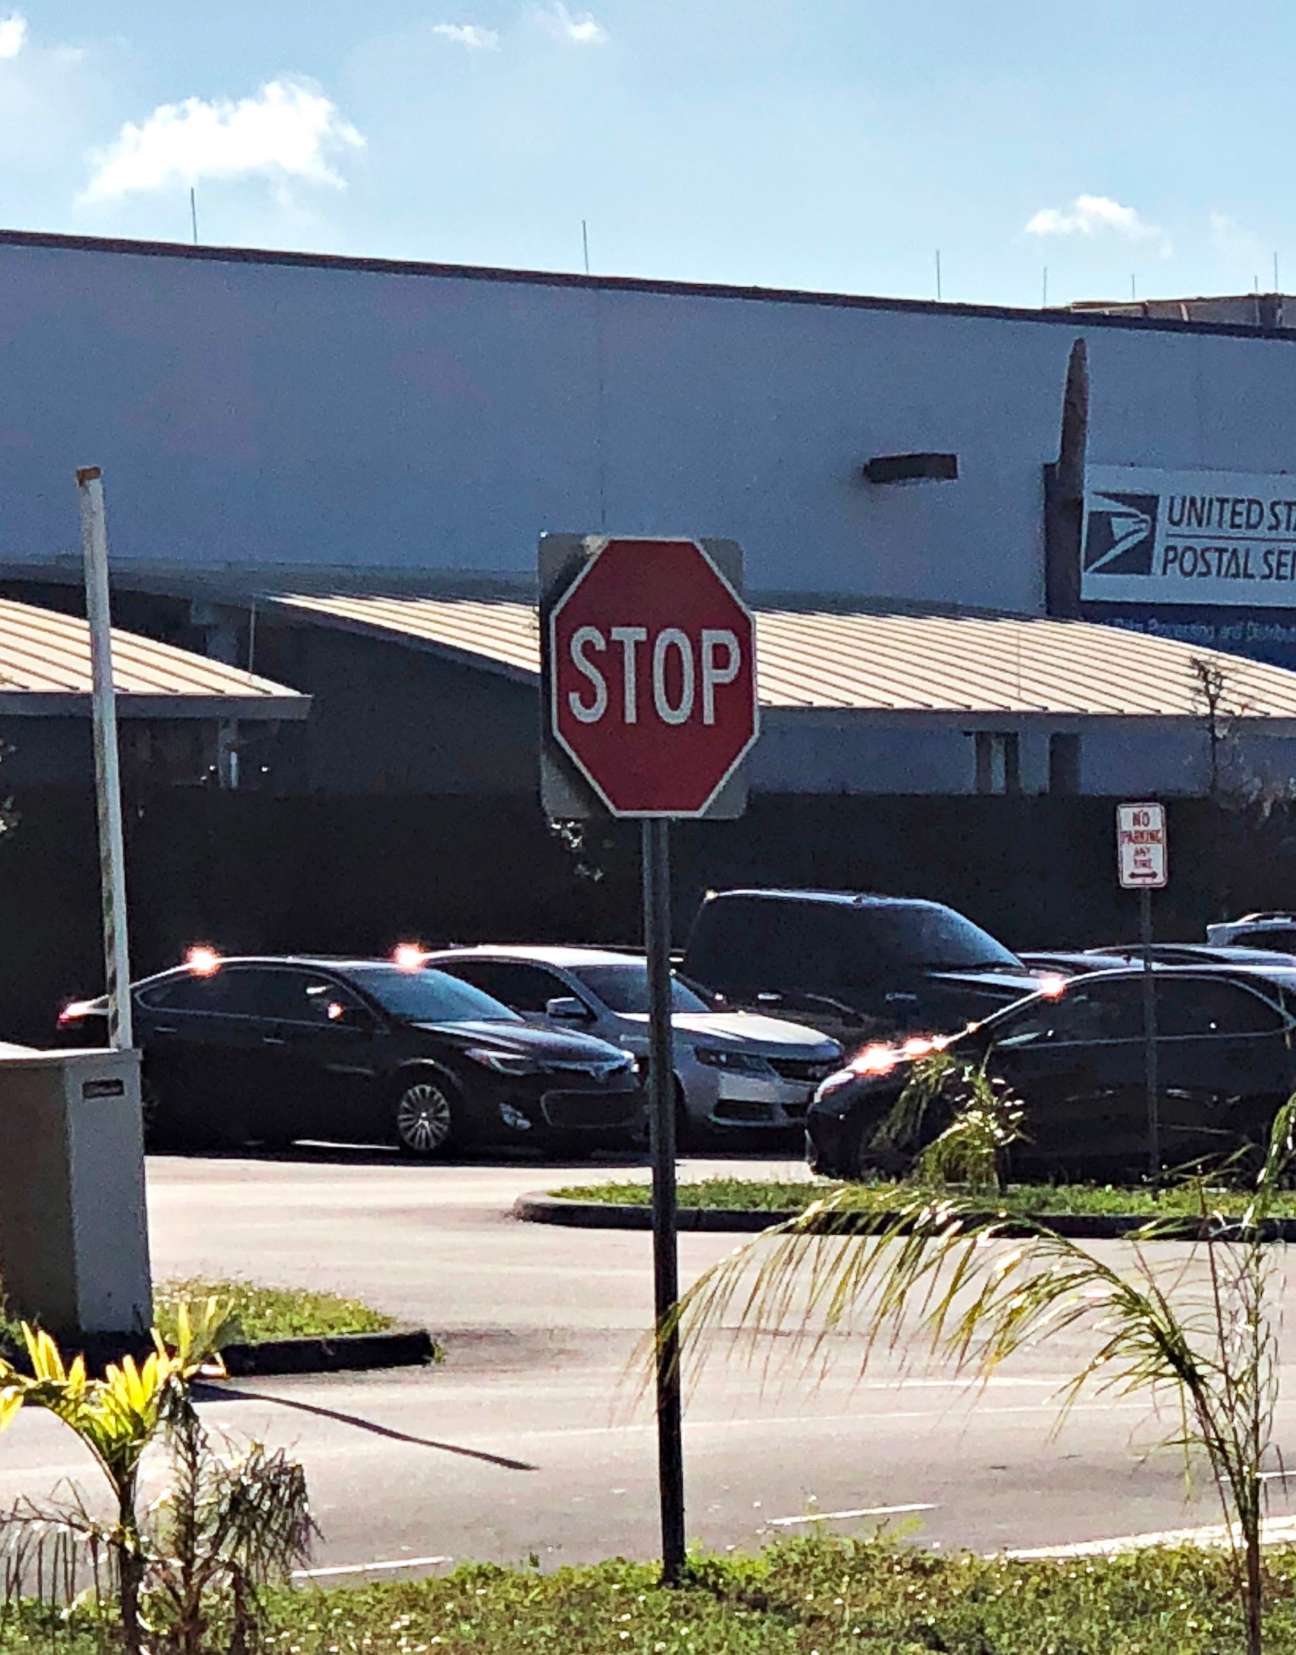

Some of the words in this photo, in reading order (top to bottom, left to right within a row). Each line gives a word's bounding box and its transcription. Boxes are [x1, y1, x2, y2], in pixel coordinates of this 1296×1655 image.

[1166, 495, 1265, 530] UNITED
[1161, 545, 1255, 580] POSTAL
[1219, 622, 1242, 641] and
[568, 625, 741, 726] STOP
[1132, 811, 1150, 827] NO
